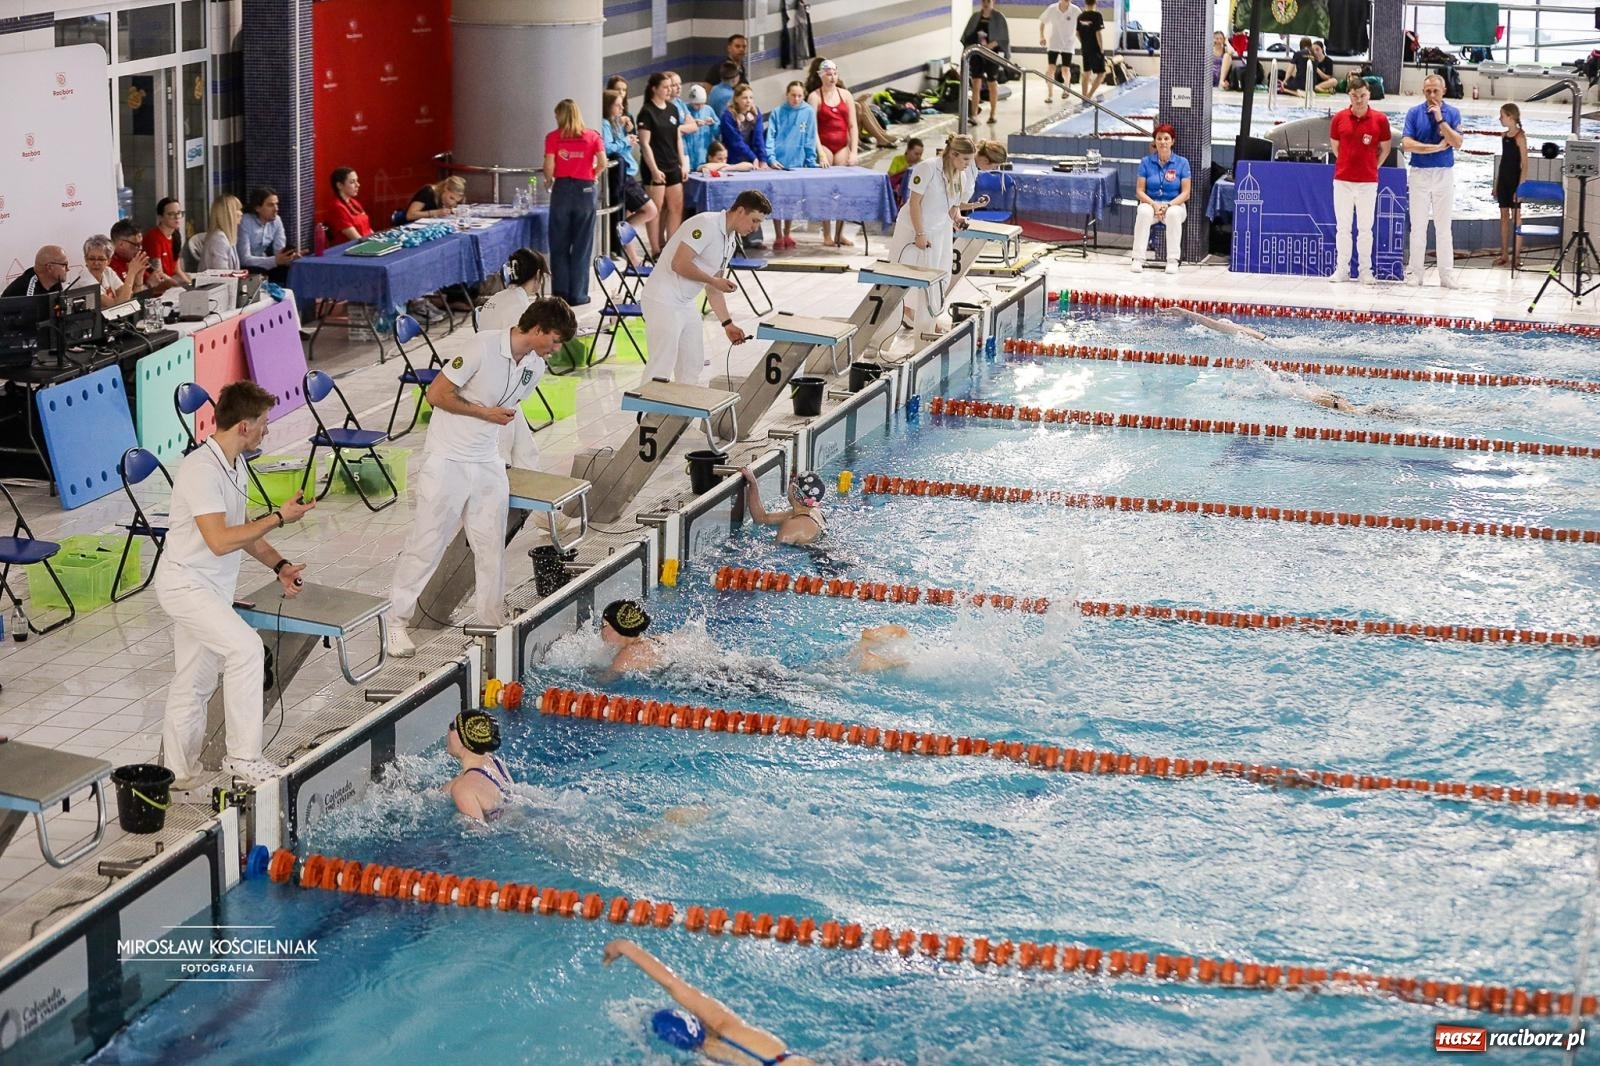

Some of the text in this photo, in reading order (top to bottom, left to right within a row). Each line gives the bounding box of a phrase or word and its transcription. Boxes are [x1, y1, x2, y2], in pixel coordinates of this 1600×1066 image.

[869, 295, 883, 325] 7
[765, 352, 782, 385] 6
[638, 425, 658, 463] 5
[353, 471, 360, 482] 5
